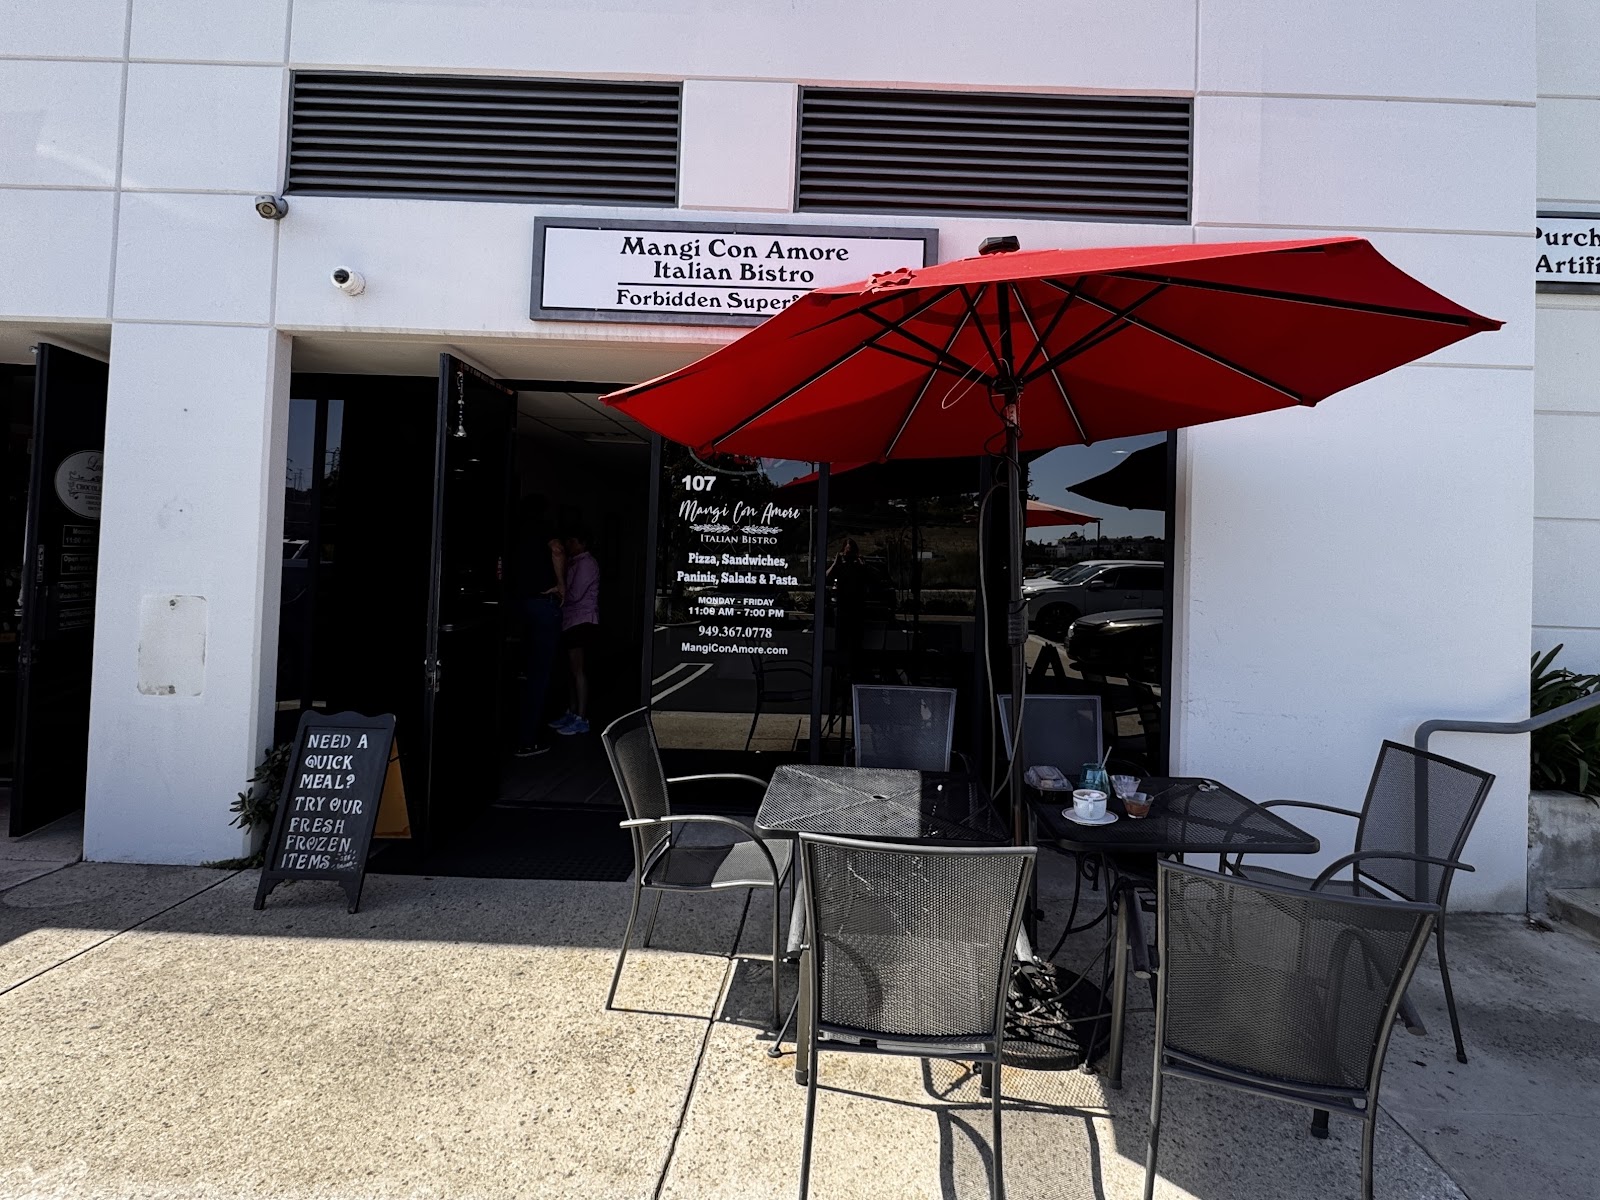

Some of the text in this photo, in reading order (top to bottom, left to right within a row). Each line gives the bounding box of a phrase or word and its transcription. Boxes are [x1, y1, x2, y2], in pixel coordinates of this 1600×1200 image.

[620, 236, 849, 261] Mangi Con Amore
[653, 260, 814, 283] Italian Bistro
[616, 289, 722, 308] Forbidden
[681, 475, 717, 491] 107
[678, 499, 801, 525] Mangi Con Amore
[700, 533, 778, 545] ITALIAN BISTRO
[688, 552, 788, 569] Pizza, Sandwiches,
[677, 571, 798, 586] Paninis, Salads & Pasta
[698, 596, 735, 605] MONDAY
[743, 598, 774, 607] FRIDAY
[688, 606, 716, 616] 11:00
[718, 608, 734, 617] AM
[744, 608, 766, 617] 7:00
[769, 609, 784, 618] PM
[698, 626, 773, 639] 949.367.0778
[681, 642, 788, 655] MangiConAmore.com
[307, 734, 369, 749] NEED A
[305, 754, 353, 770] QUICK
[299, 774, 356, 789] MEAL?
[294, 796, 363, 815] TRY OUR
[288, 817, 345, 834] FRESH
[285, 835, 352, 852] FROZEN
[280, 852, 331, 870] ITEMS
